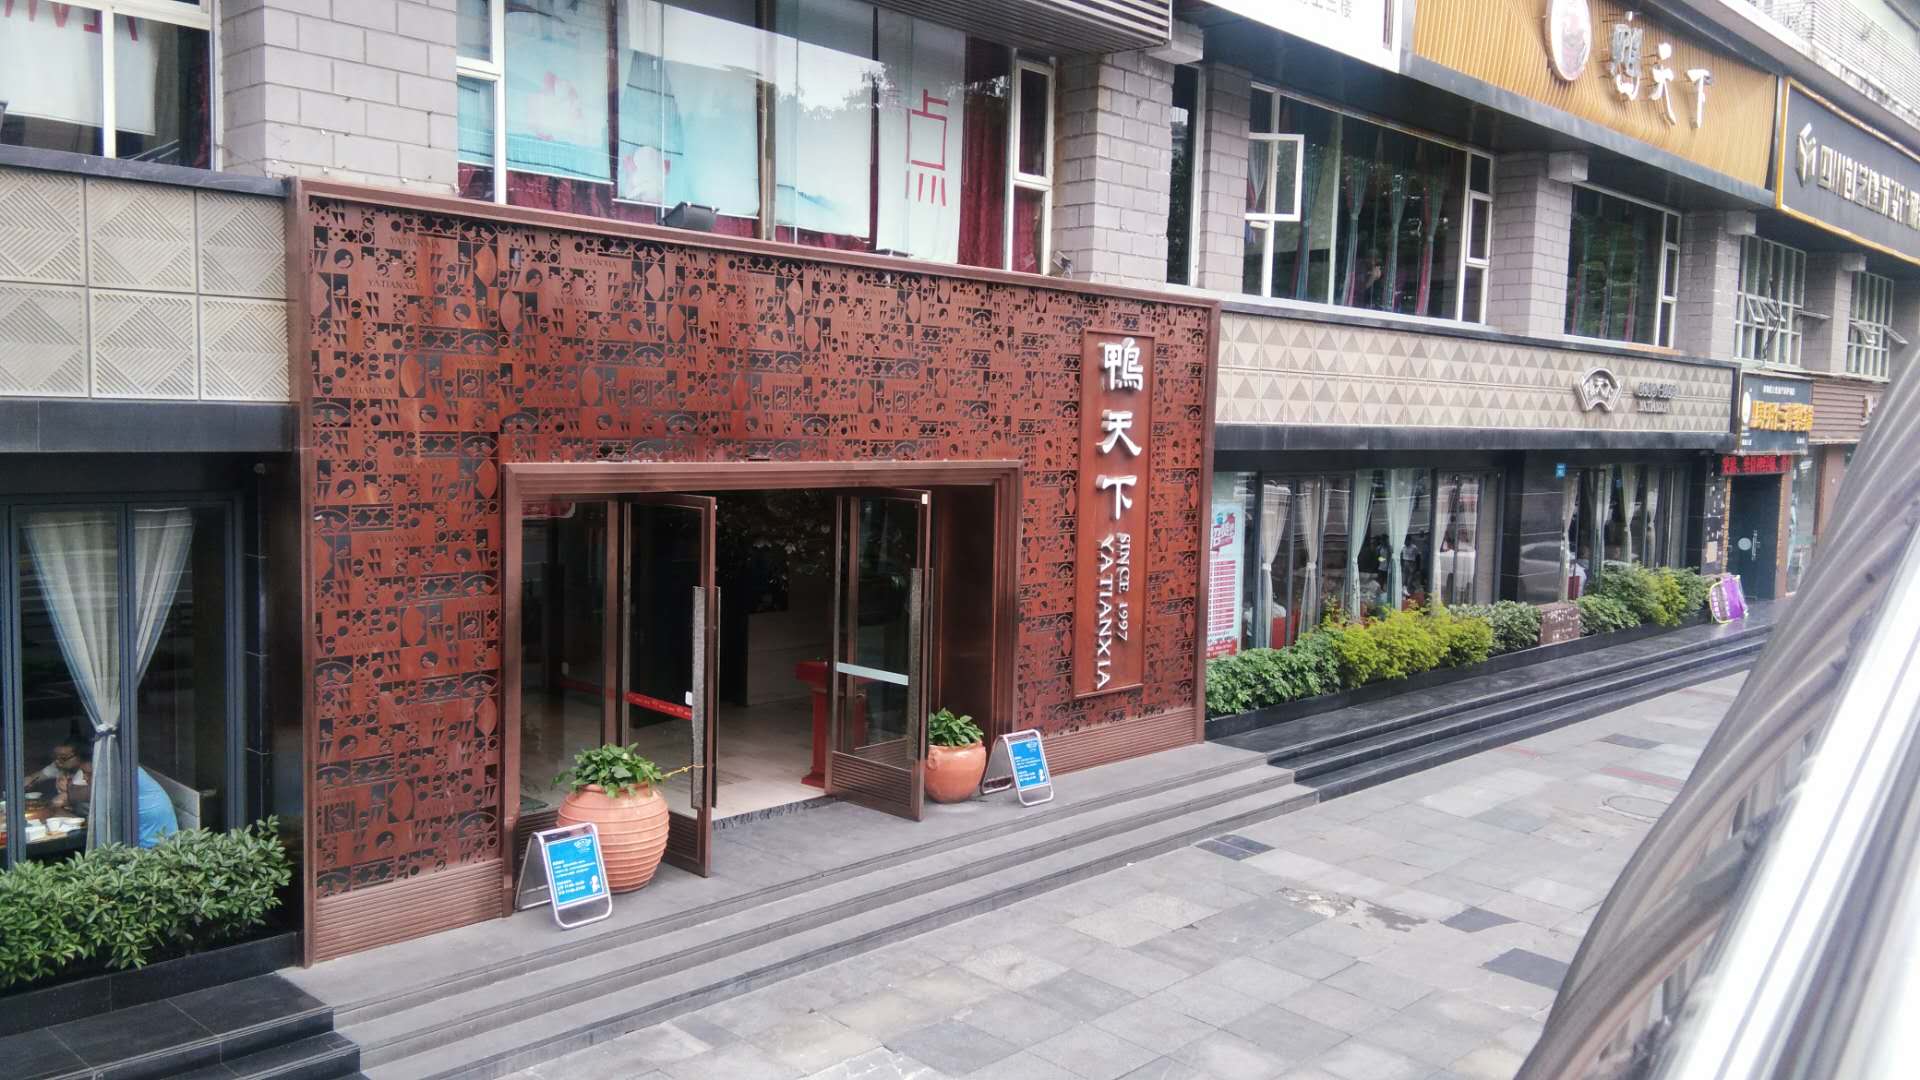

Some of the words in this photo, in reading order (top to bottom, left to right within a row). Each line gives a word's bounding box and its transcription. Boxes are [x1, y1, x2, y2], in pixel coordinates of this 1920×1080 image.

[905, 89, 948, 206] 点
[1117, 532, 1131, 594] SINCE
[1096, 534, 1115, 690] YATIANXIA
[1117, 602, 1129, 642] 1997
